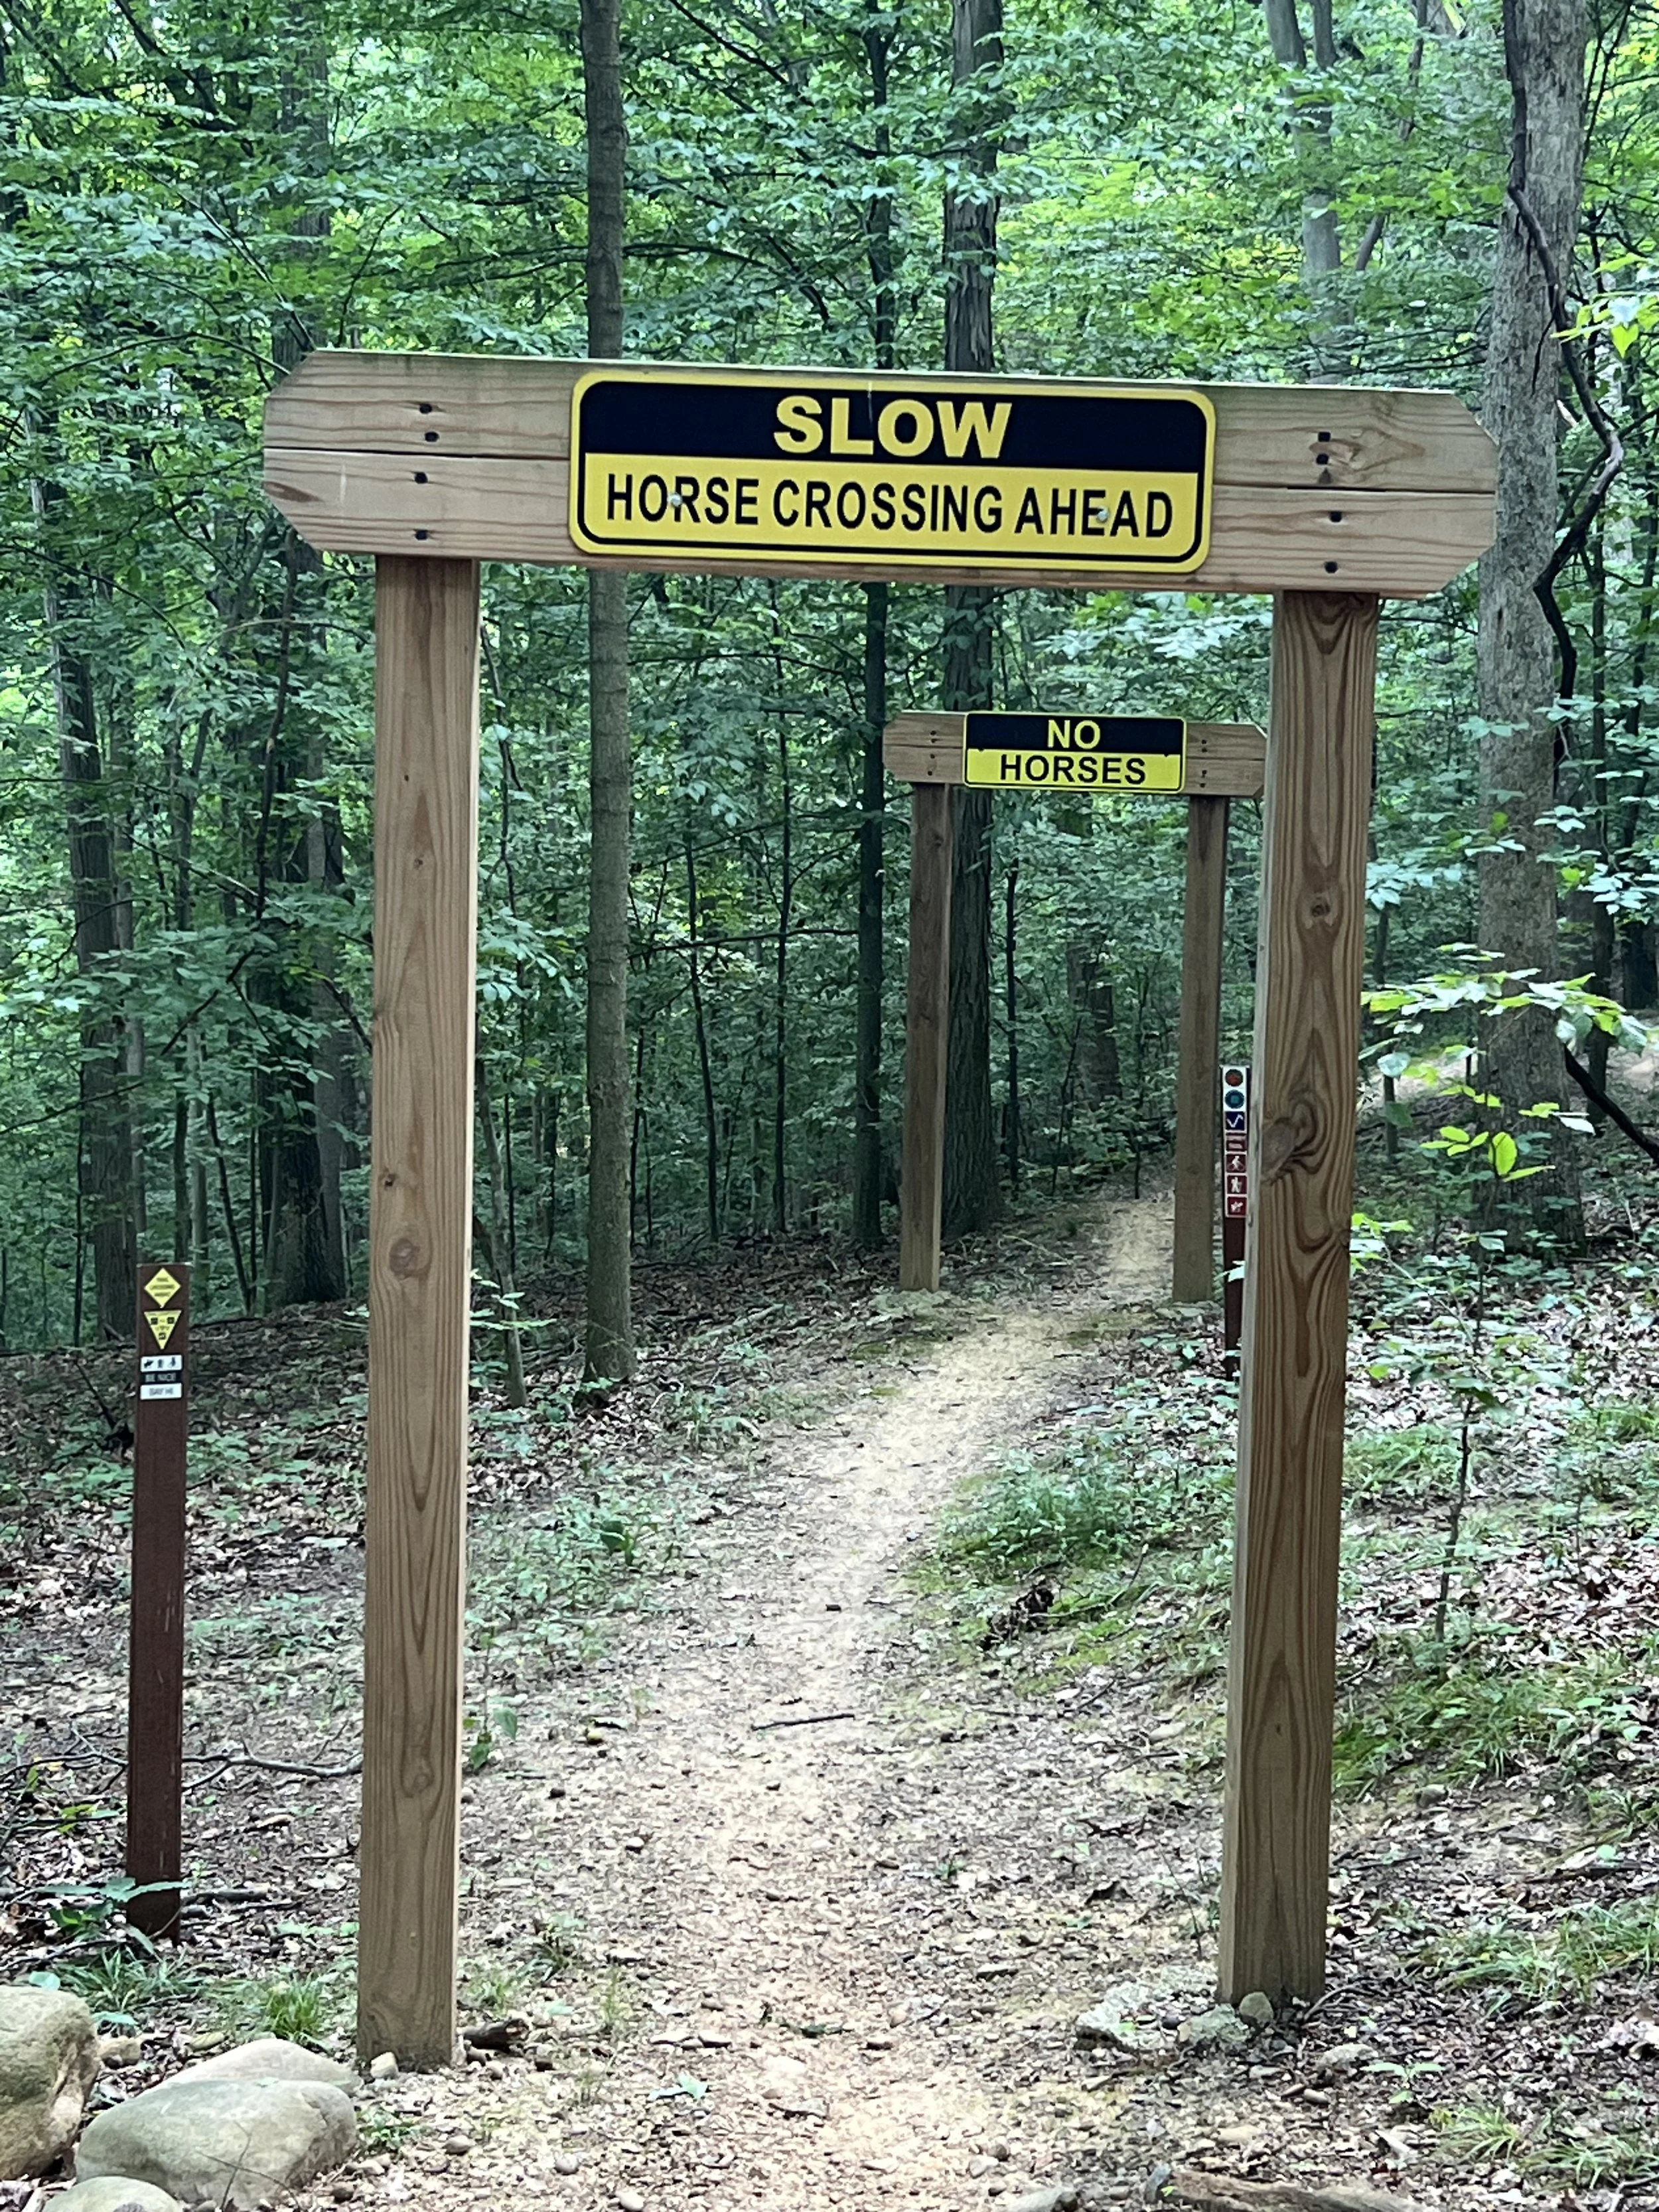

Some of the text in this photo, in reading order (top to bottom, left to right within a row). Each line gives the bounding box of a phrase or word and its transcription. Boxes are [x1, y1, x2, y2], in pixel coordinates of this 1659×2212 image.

[774, 396, 1013, 459] SLOW
[607, 472, 1173, 538] HORSE CROSSING AHEAD
[1048, 720, 1101, 749] NO
[1001, 755, 1145, 784] HORSES
